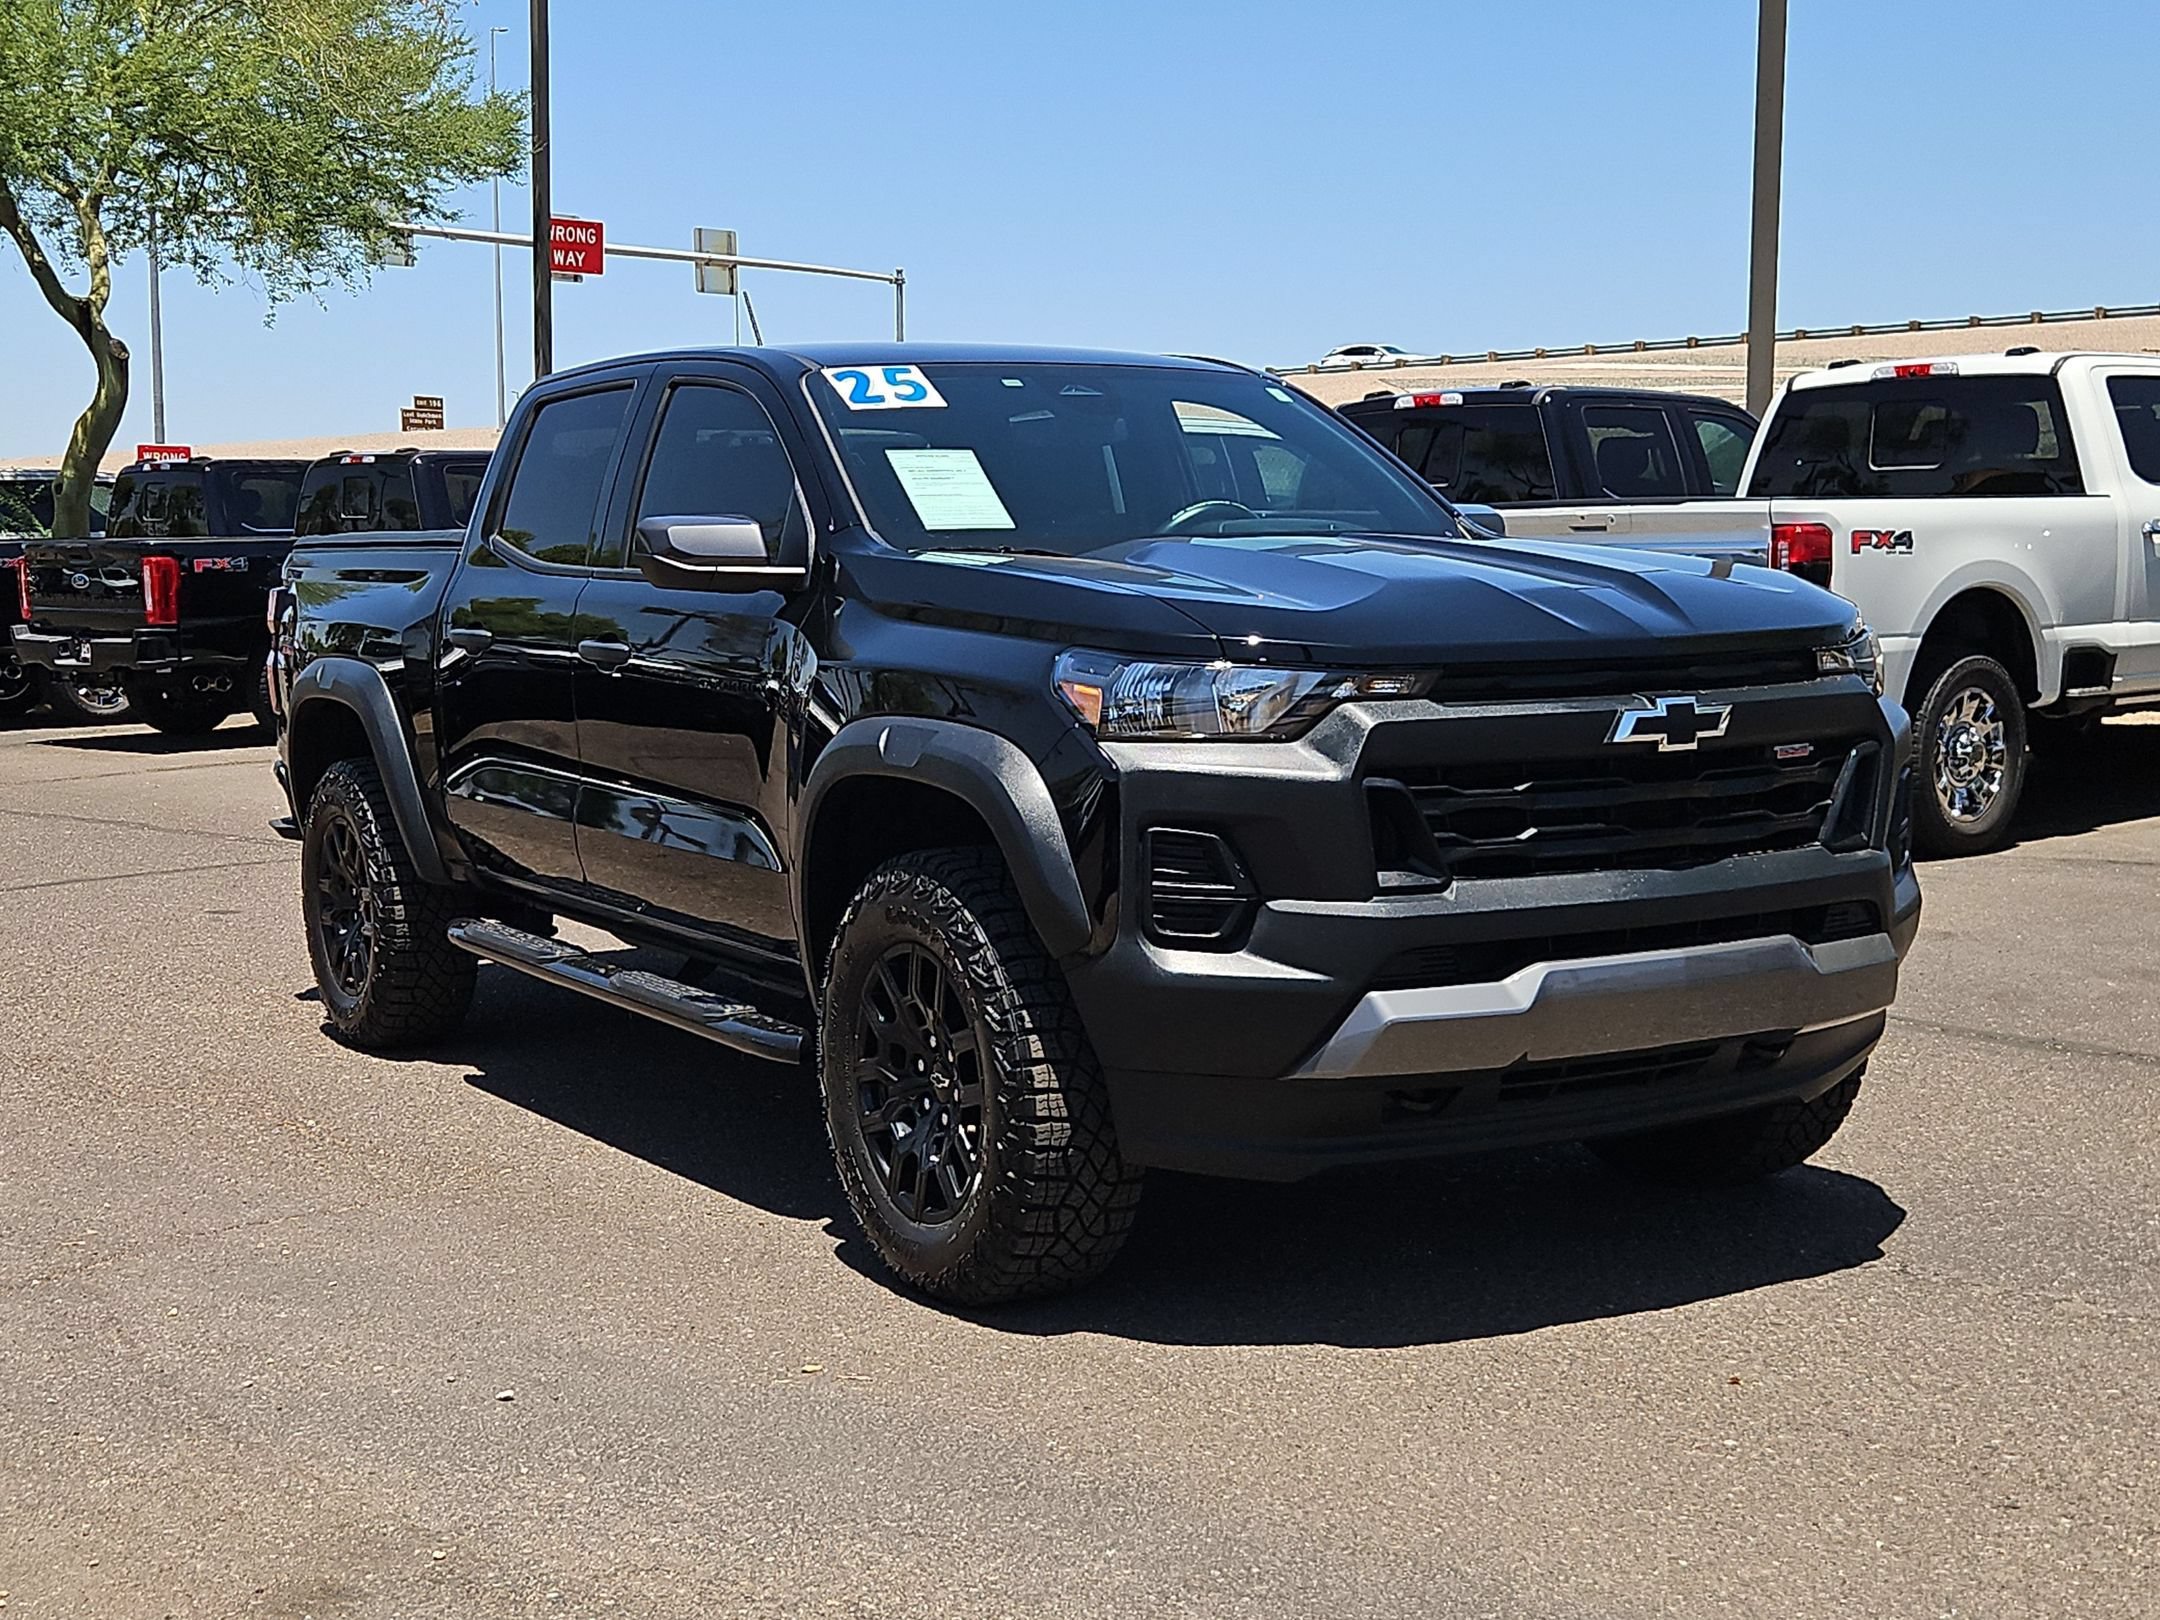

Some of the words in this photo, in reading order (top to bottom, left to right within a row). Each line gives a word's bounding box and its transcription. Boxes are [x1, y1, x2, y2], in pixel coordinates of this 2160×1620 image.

[553, 249, 586, 267] WAY
[831, 367, 928, 404] 25
[1851, 530, 1914, 554] FX4
[193, 557, 249, 573] FX4
